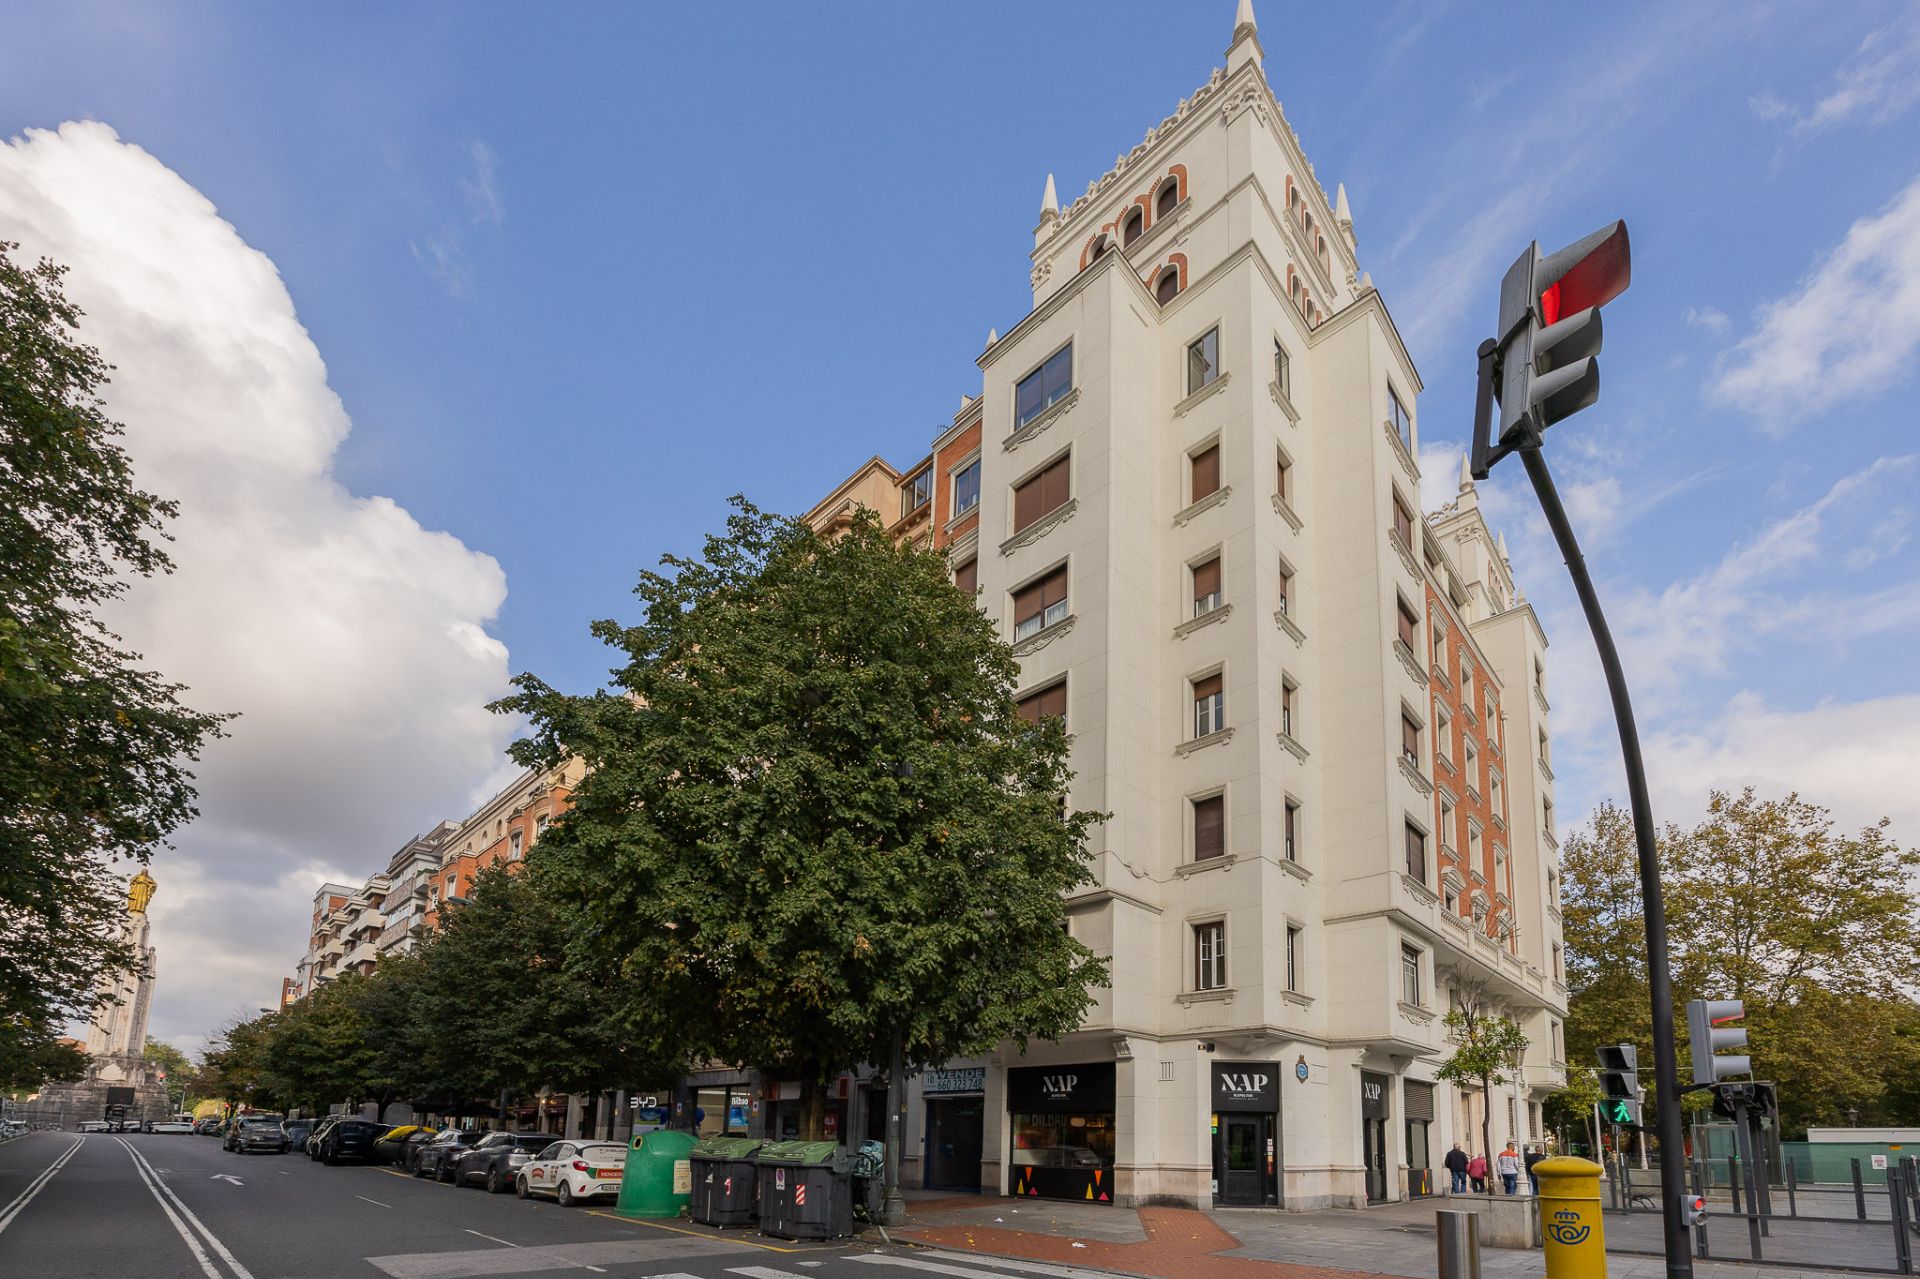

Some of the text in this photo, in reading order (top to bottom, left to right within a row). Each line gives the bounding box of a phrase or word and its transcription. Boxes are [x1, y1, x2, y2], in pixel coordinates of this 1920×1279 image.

[938, 1069, 983, 1079] VENDE
[937, 1079, 951, 1090] 660
[952, 1079, 966, 1090] 323
[1043, 1075, 1077, 1092] NAP
[1221, 1073, 1268, 1092] NAP
[1364, 1082, 1381, 1100] NAP
[630, 1096, 657, 1108] BYD
[731, 1096, 749, 1106] Bilbao
